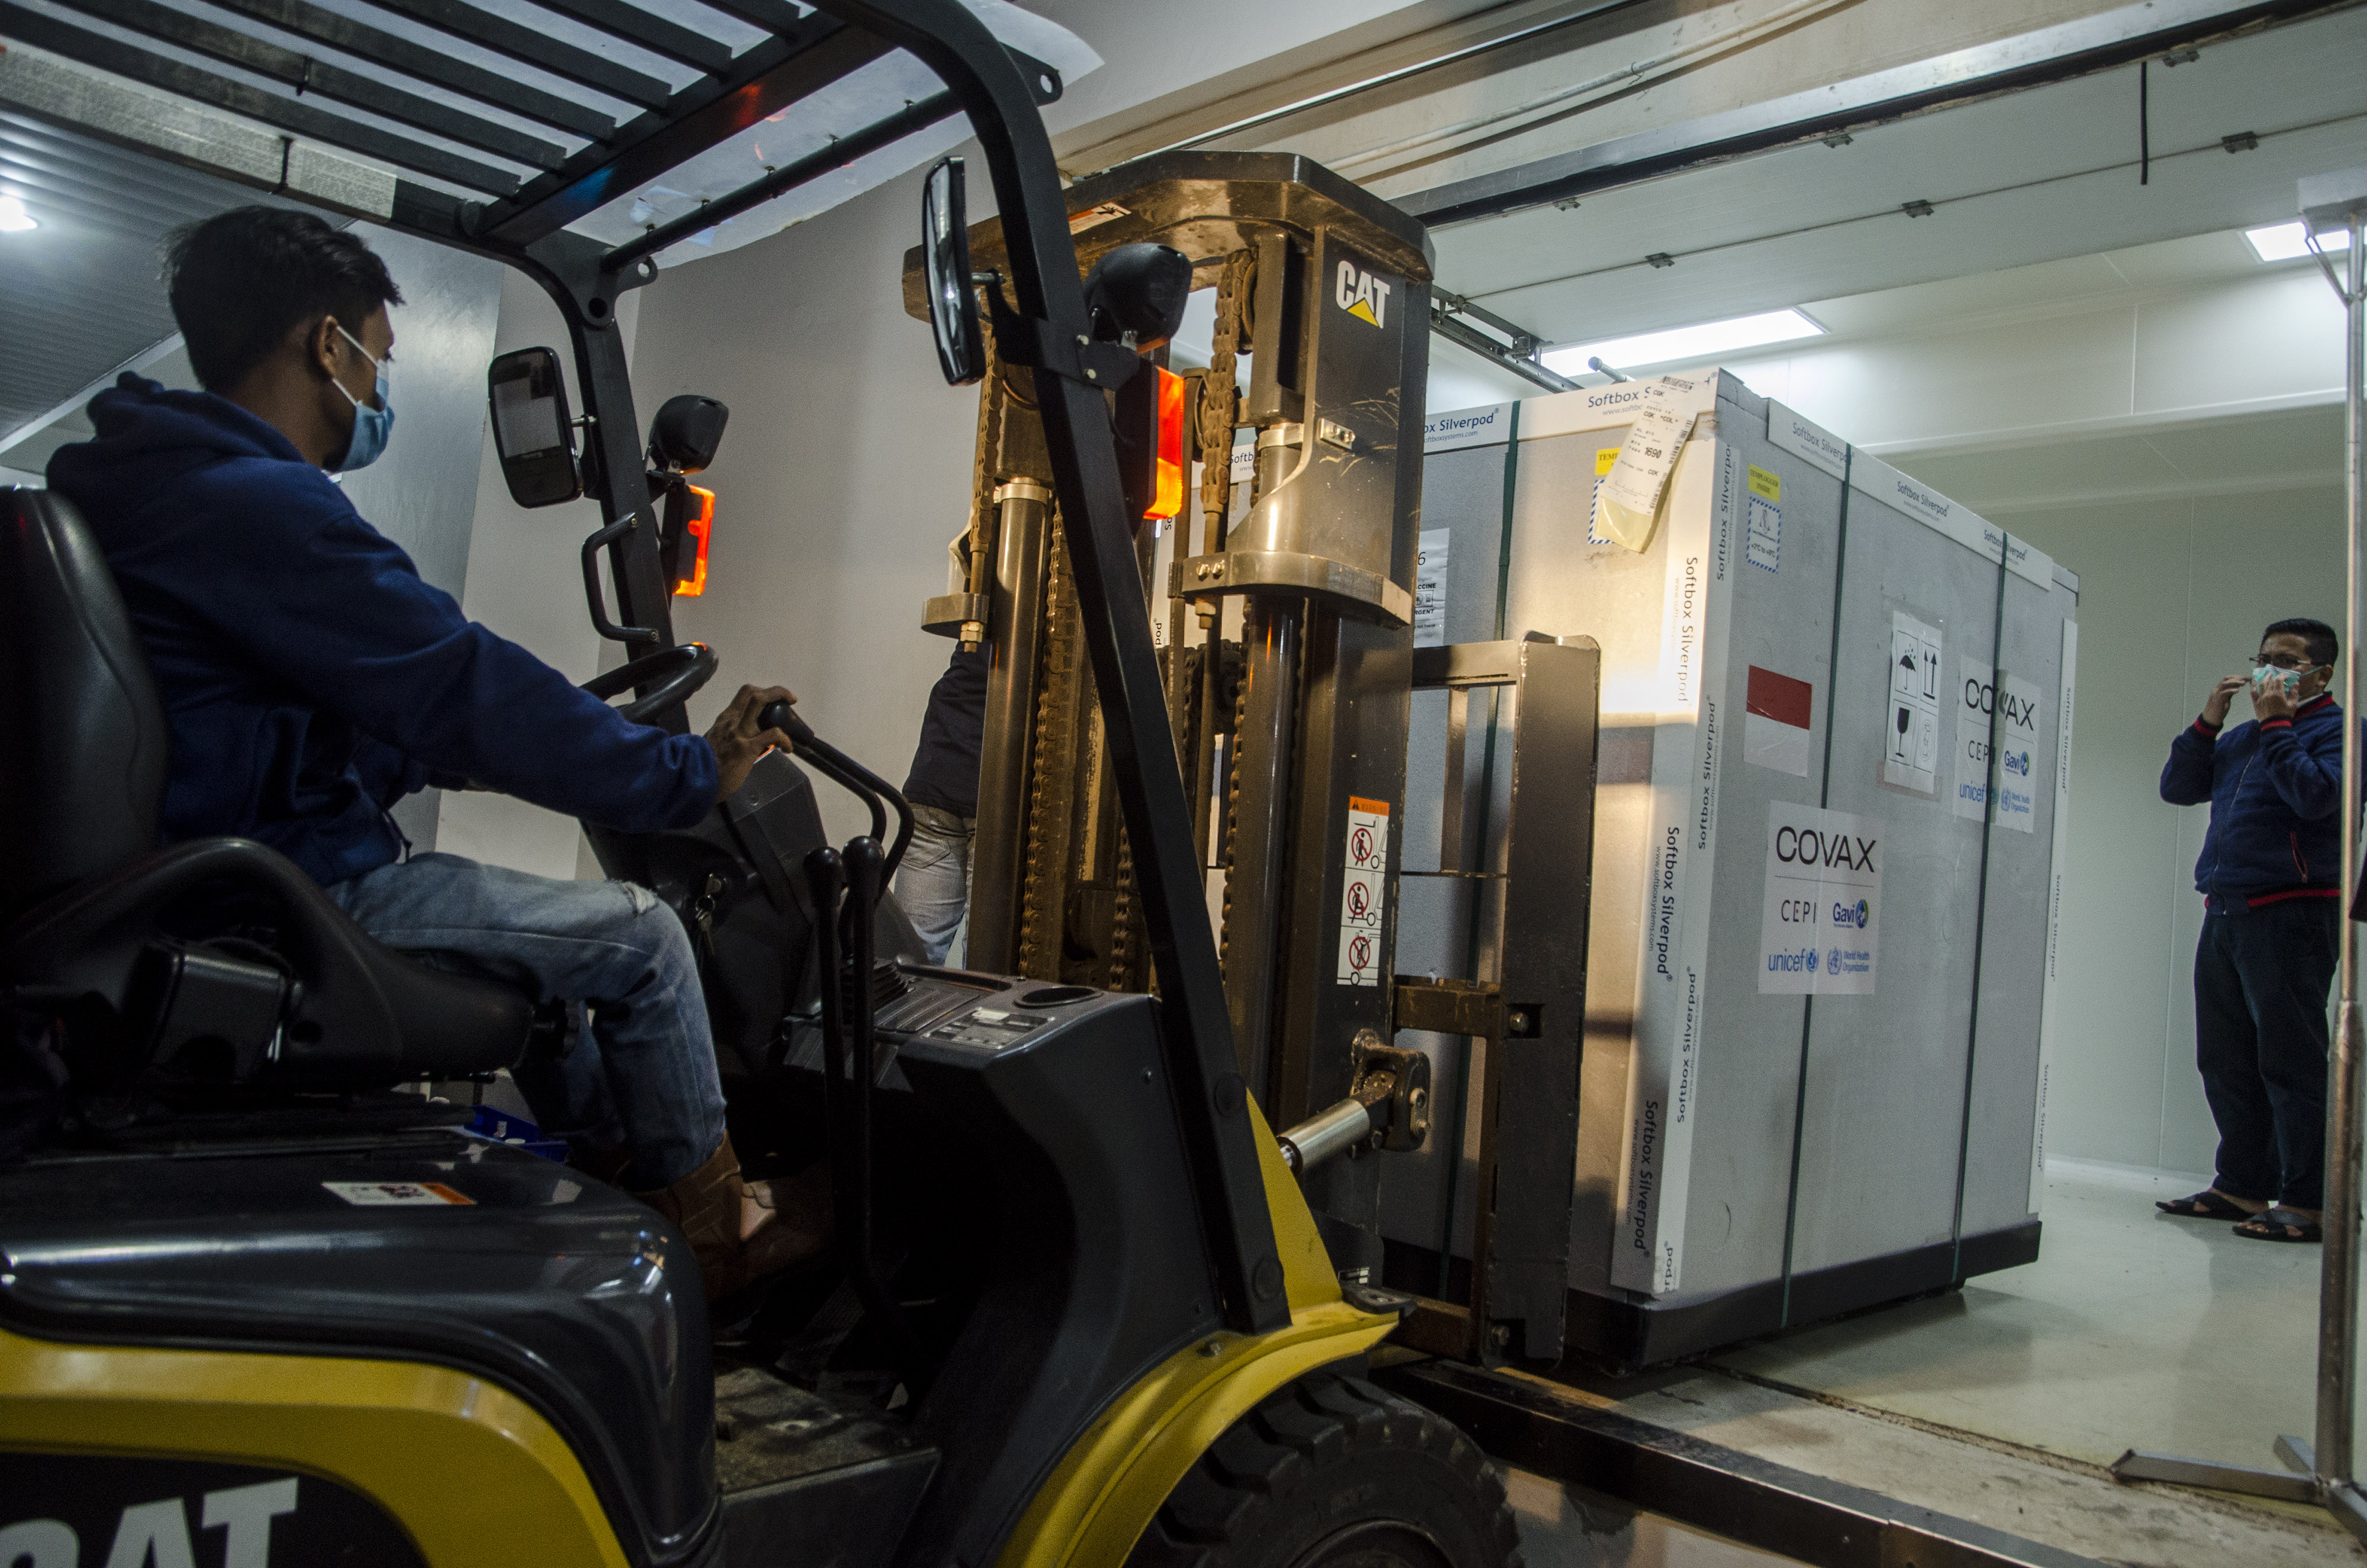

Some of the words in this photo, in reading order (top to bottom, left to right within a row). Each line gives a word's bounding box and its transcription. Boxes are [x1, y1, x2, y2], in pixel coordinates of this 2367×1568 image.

[1336, 260, 1391, 329] CAT
[1588, 391, 1639, 408] Softbox
[1792, 422, 1820, 447] Softbox
[1721, 444, 1732, 513] Silverpo
[1897, 481, 1920, 502] Softbox
[1717, 519, 1727, 581] Softbox
[1984, 530, 2003, 547] Softbox
[1682, 557, 1698, 618] Softbox
[1965, 678, 2035, 731] COAX
[1968, 740, 1989, 762] CEP
[2004, 750, 2020, 770] Gavi
[1959, 780, 1986, 803] unicef
[1698, 787, 1710, 850] Softbox
[1663, 827, 1680, 890] Softbox
[1776, 826, 1876, 873] COVAX
[1648, 846, 1662, 951] www.softboxsystems.com
[1781, 899, 1817, 924] CEPI
[1833, 902, 1855, 922] Gavi
[1768, 947, 1805, 972] unicef
[1677, 1059, 1689, 1123] Softbox
[1642, 1101, 1658, 1164] Softbox
